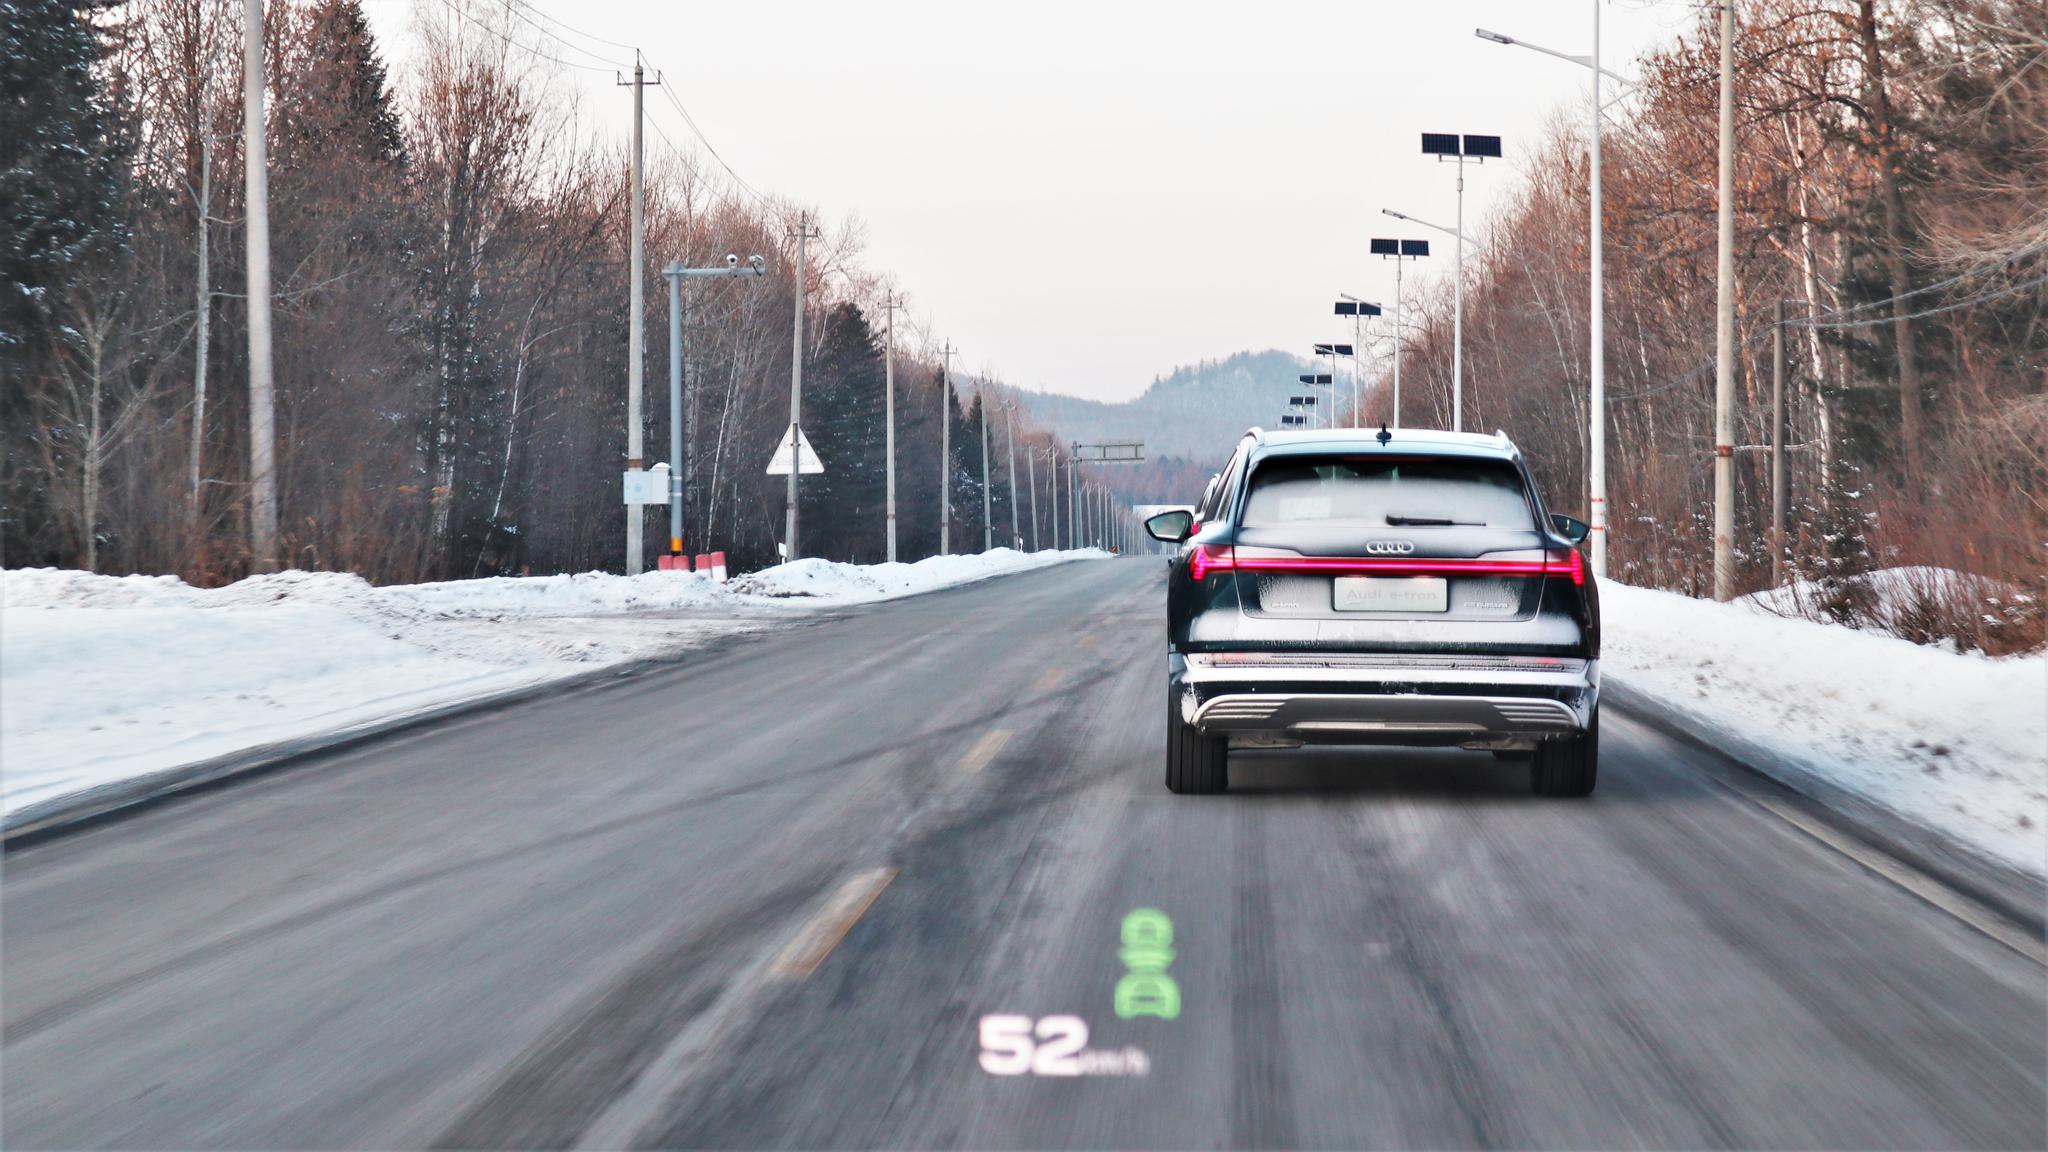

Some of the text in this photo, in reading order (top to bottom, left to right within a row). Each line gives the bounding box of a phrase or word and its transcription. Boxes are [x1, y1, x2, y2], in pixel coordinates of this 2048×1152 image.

[1346, 589, 1437, 600] Audi e-tron
[979, 1014, 1088, 1076] 52
